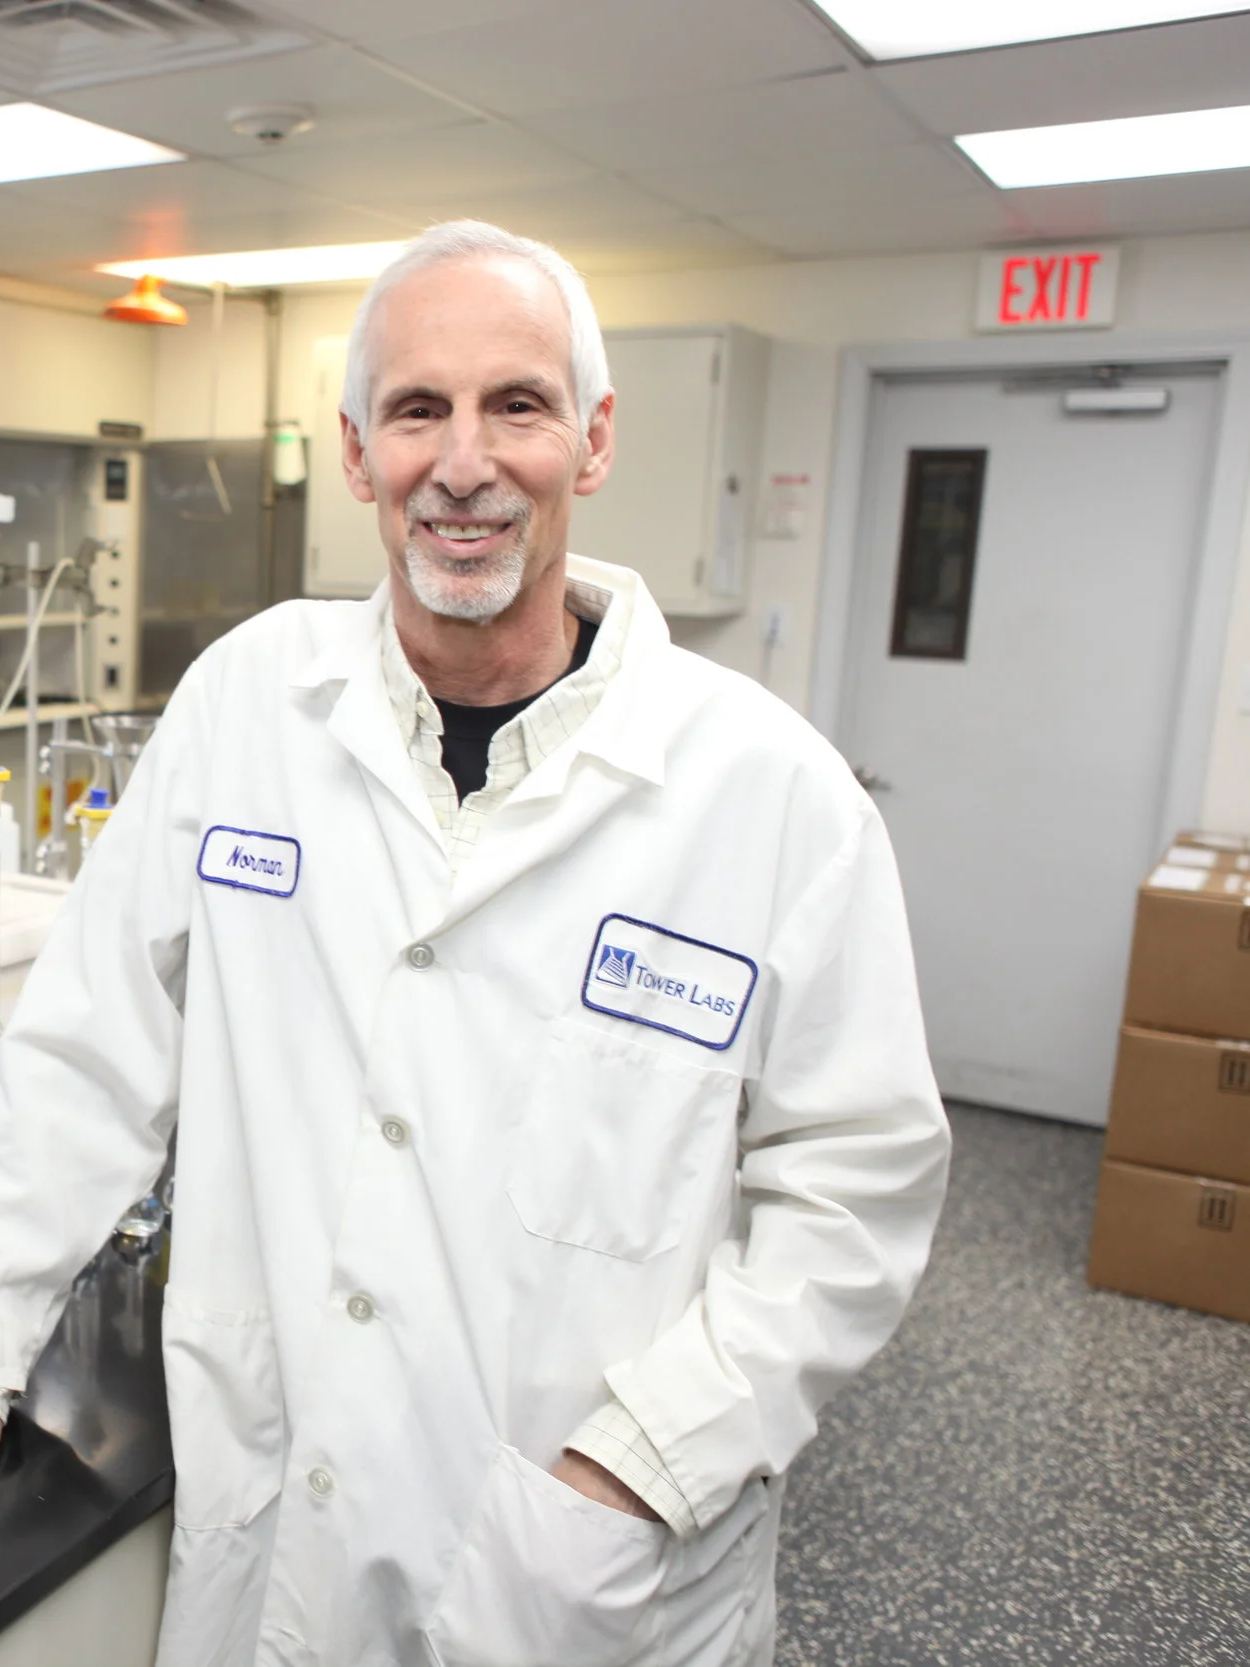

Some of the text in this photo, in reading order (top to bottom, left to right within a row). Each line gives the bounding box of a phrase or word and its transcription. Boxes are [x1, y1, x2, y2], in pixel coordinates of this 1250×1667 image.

[999, 254, 1102, 323] EXIT
[226, 845, 284, 876] Norman
[635, 965, 736, 1016] TOWER LABS
